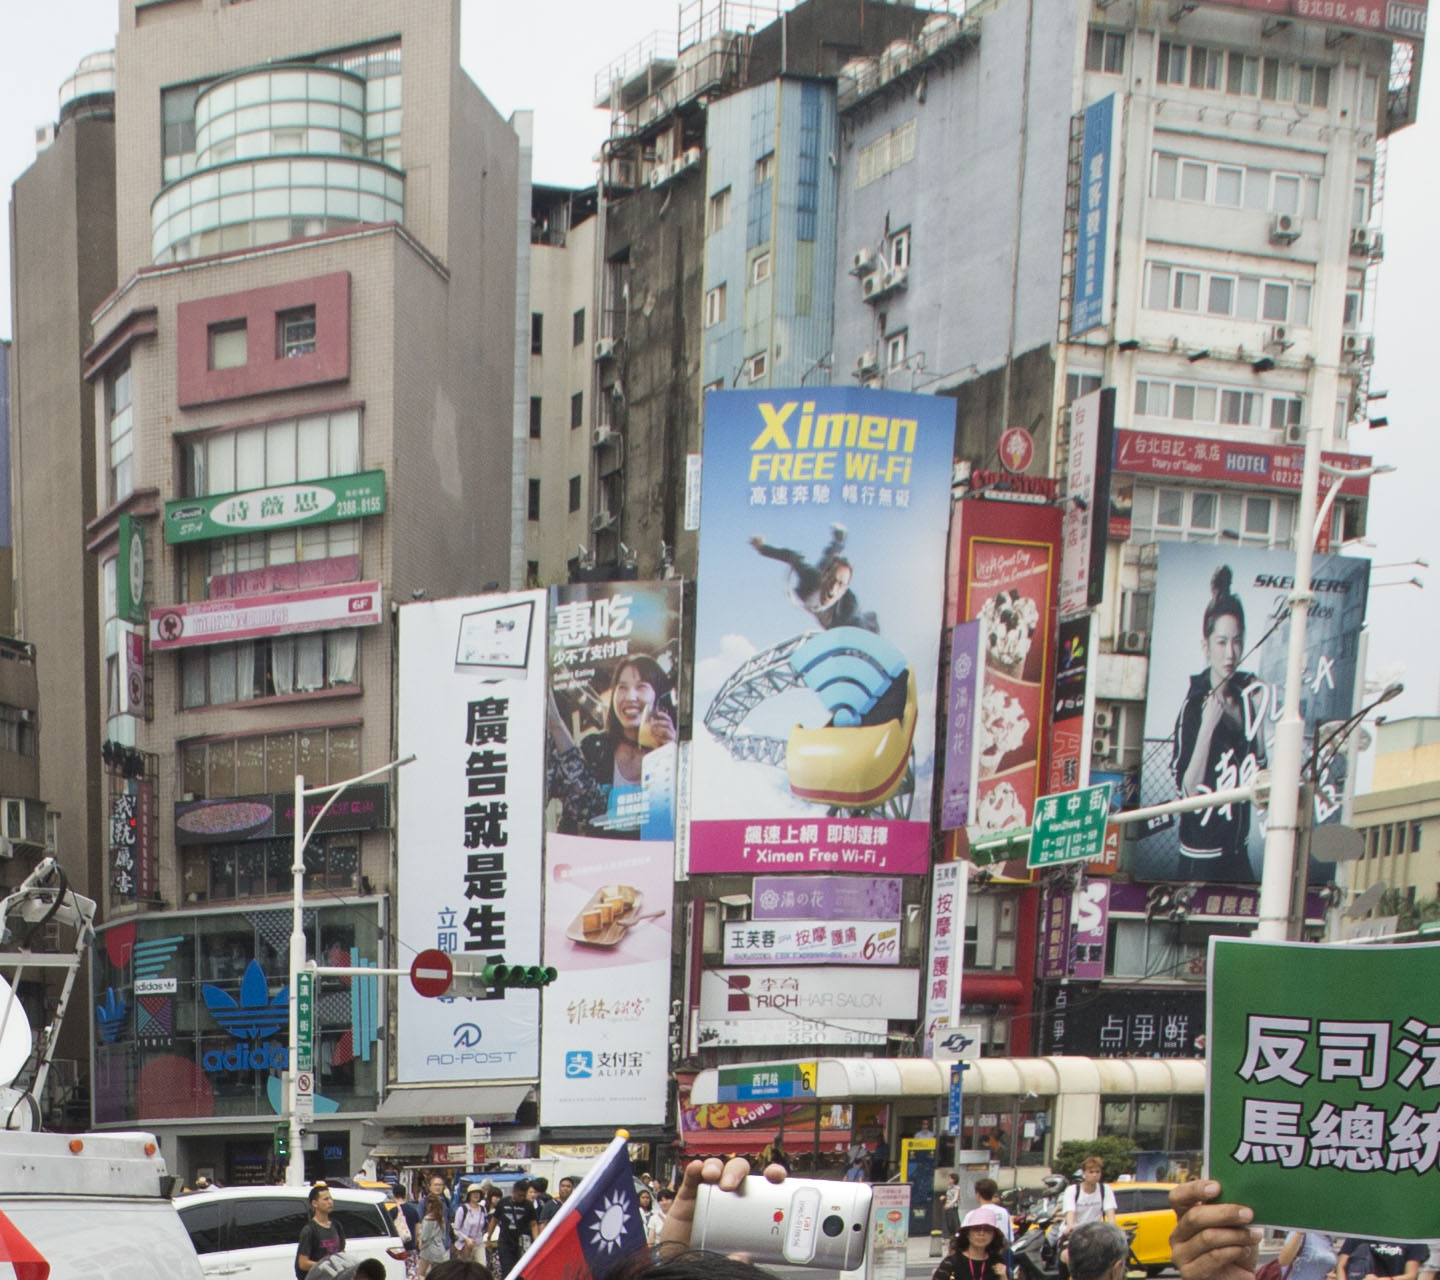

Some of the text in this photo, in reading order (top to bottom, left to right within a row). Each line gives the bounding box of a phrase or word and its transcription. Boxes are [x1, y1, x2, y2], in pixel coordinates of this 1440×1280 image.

[1389, 4, 1428, 31] HOTE
[749, 400, 918, 454] Ximen
[749, 452, 913, 485] FREE Wi-Fi
[1226, 453, 1268, 474] HOTEL
[1252, 573, 1353, 595] SKEERS
[351, 597, 369, 611] 6F
[553, 594, 633, 648] 惠吃
[756, 847, 877, 865] Ximen Free Wi-Fi
[757, 993, 799, 1009] RICH
[835, 993, 883, 1009] SALON
[203, 1042, 290, 1073] adida
[426, 1051, 517, 1066] AD-POST
[597, 1051, 643, 1068] 支付宝
[598, 1068, 642, 1077] ALIPAY
[752, 1073, 779, 1088] 西門站
[802, 1071, 811, 1092] 6
[731, 1102, 774, 1128] FLOWE
